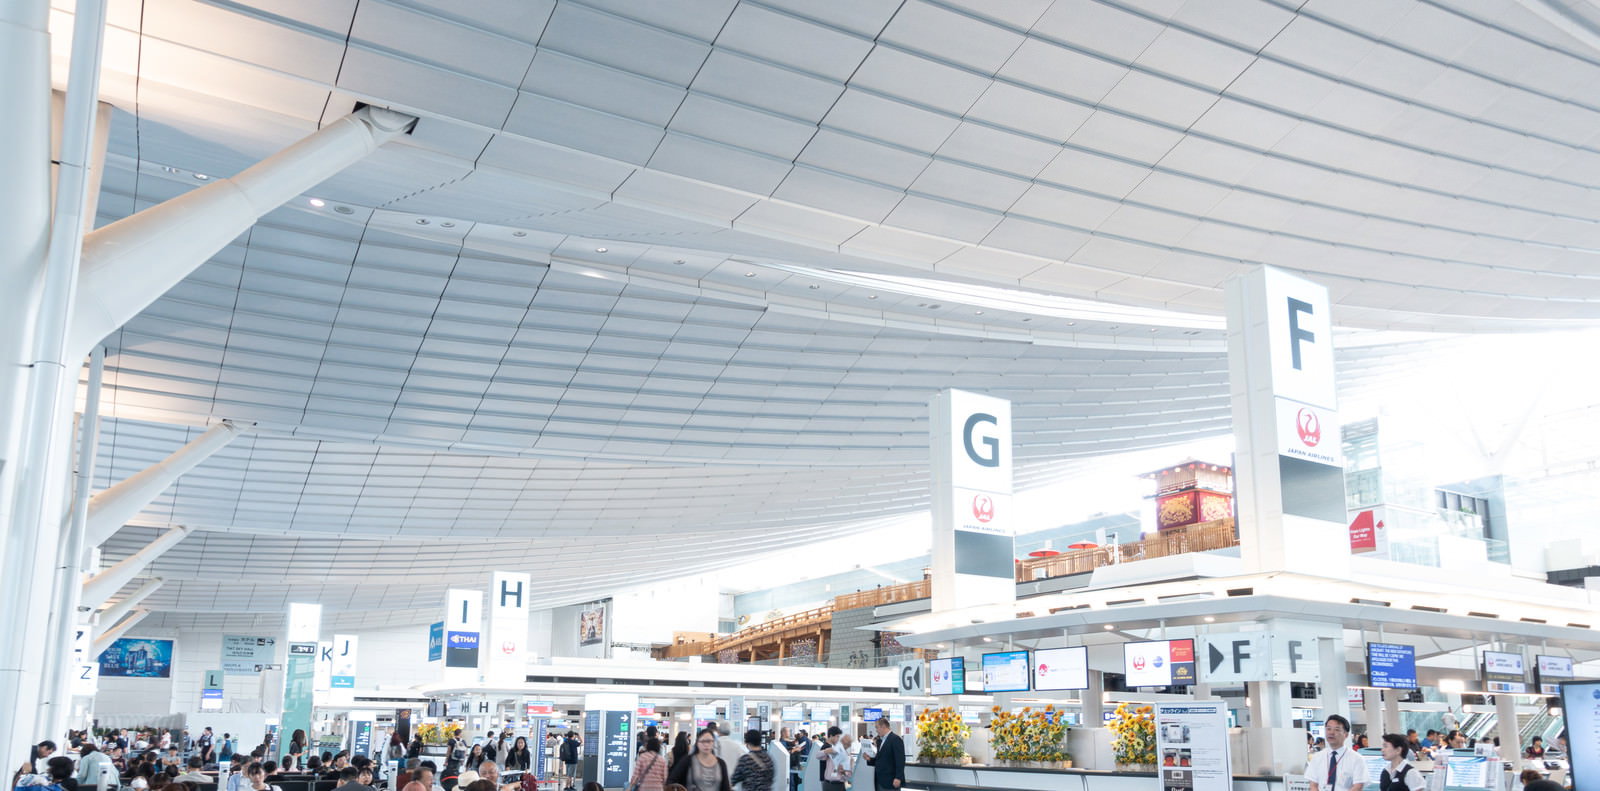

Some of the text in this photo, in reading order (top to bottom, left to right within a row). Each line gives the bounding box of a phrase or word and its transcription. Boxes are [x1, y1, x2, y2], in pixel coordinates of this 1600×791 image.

[1287, 296, 1315, 371] F
[963, 412, 1000, 468] G
[1287, 447, 1335, 463] JAPAN AIRLINES
[500, 580, 523, 608] H
[462, 599, 468, 624] I
[321, 646, 333, 662] K
[340, 640, 349, 657] J
[1232, 640, 1251, 673] F
[1288, 641, 1303, 673] F
[80, 665, 93, 680] Z
[210, 674, 218, 687] L
[901, 665, 913, 692] G
[479, 701, 489, 713] H
